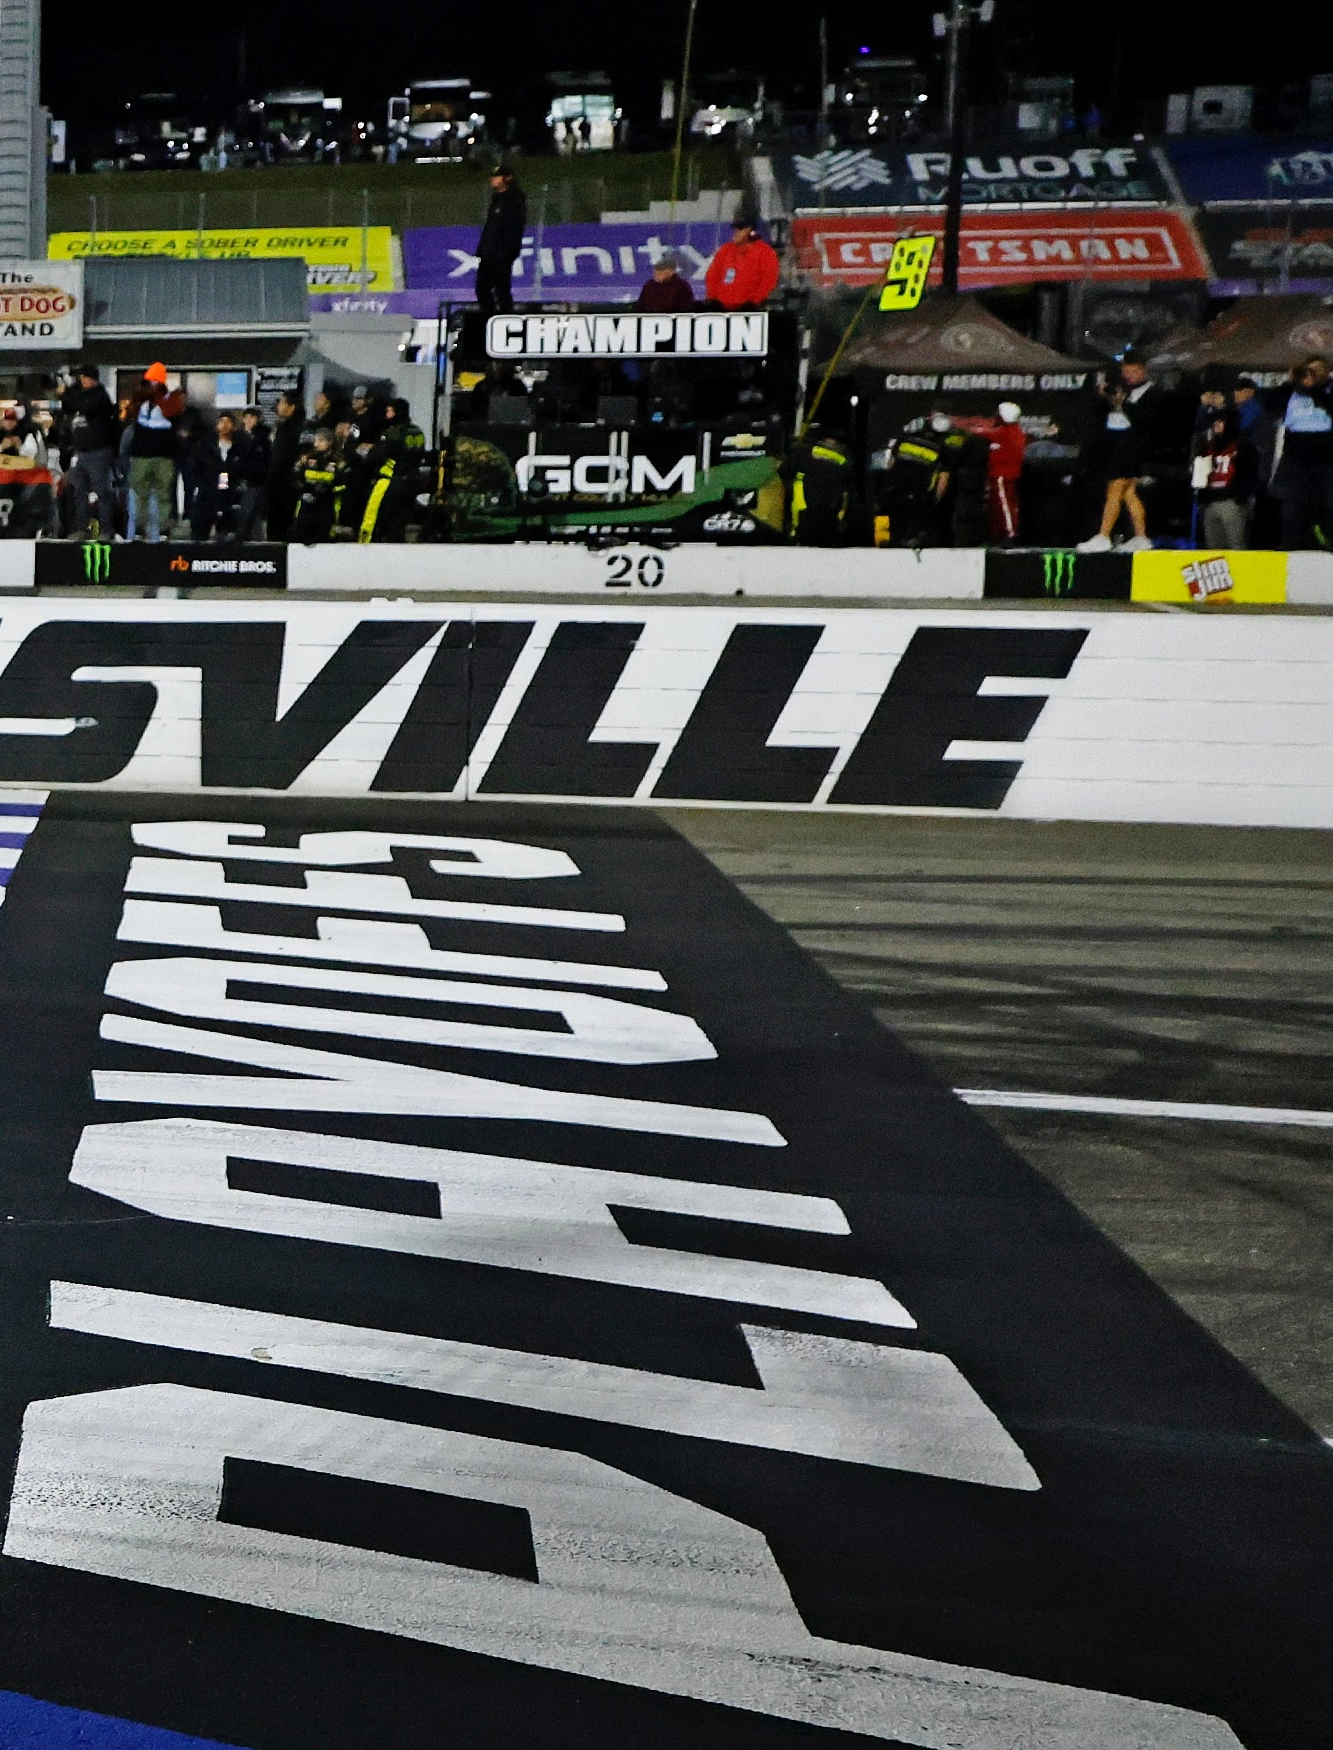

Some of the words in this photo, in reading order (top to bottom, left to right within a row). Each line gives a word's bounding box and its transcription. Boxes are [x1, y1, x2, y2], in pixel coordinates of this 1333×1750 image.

[66, 238, 154, 252] CHOOSE
[162, 238, 178, 250] A
[185, 237, 259, 250] SOBER
[265, 236, 350, 249] DRIVER
[0, 271, 34, 284] The
[20, 296, 67, 314] DOG
[491, 315, 764, 354] CHAMPION
[885, 374, 938, 391] CREW
[941, 374, 1035, 391] MEMBERS
[1039, 374, 1087, 391] ONLY
[190, 560, 238, 573] RITCHIE
[239, 561, 277, 574] BROS.
[604, 554, 664, 588] 20
[2, 821, 1244, 1750] PLAYOFFS
